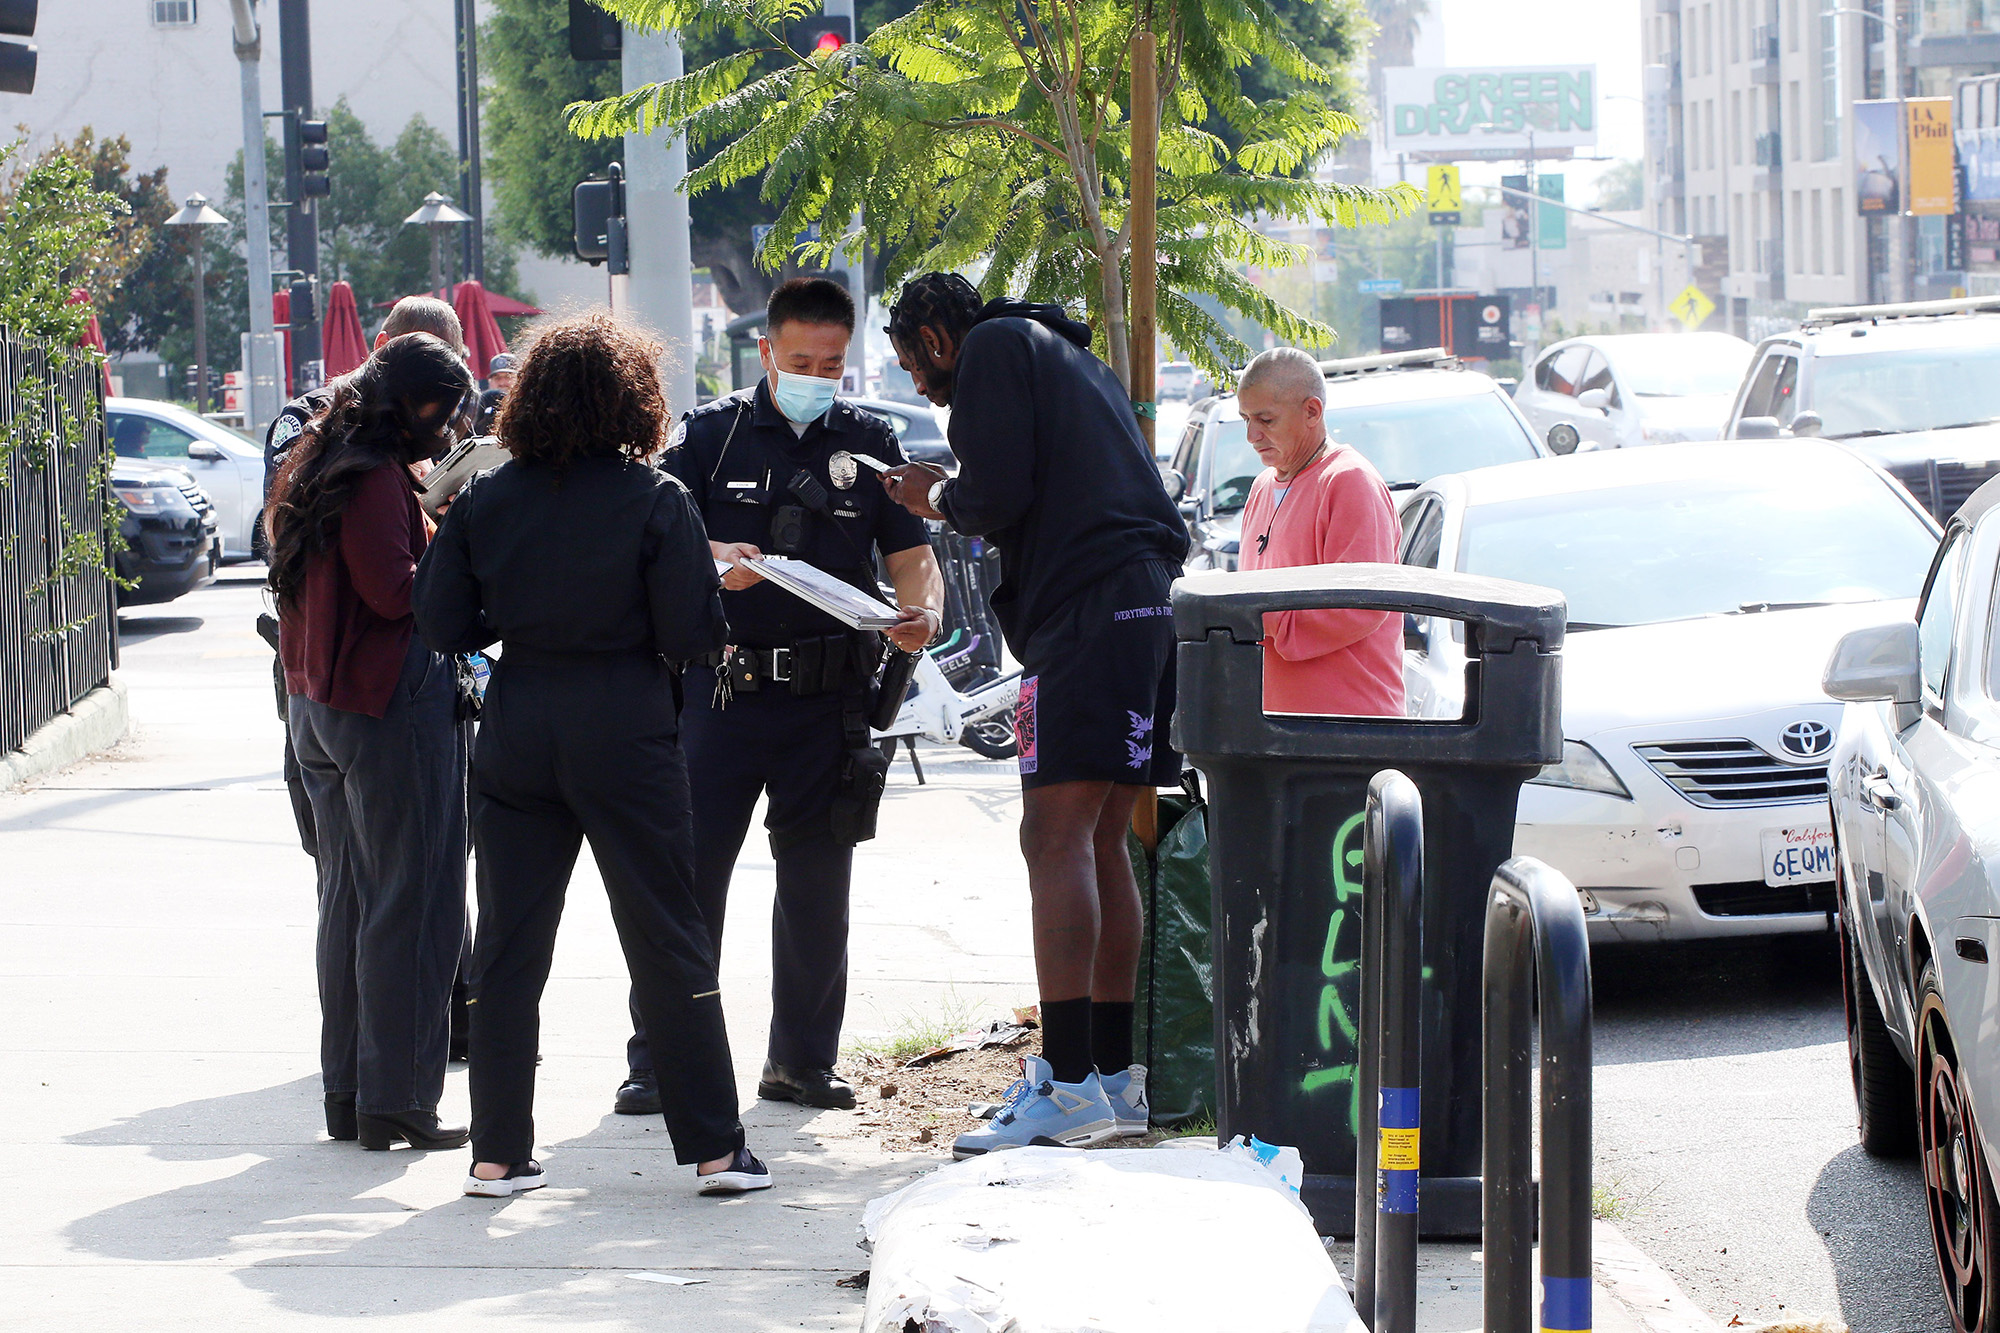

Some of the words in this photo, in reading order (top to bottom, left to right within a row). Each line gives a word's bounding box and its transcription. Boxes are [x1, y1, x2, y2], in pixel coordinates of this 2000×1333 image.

[1434, 71, 1592, 105] GREEN
[1913, 107, 1933, 121] LA
[1913, 122, 1948, 138] Phil
[967, 562, 977, 590] WHEELS
[1155, 606, 1162, 616] IS
[941, 654, 971, 674] EELS
[1773, 846, 1836, 877] 6EQM
